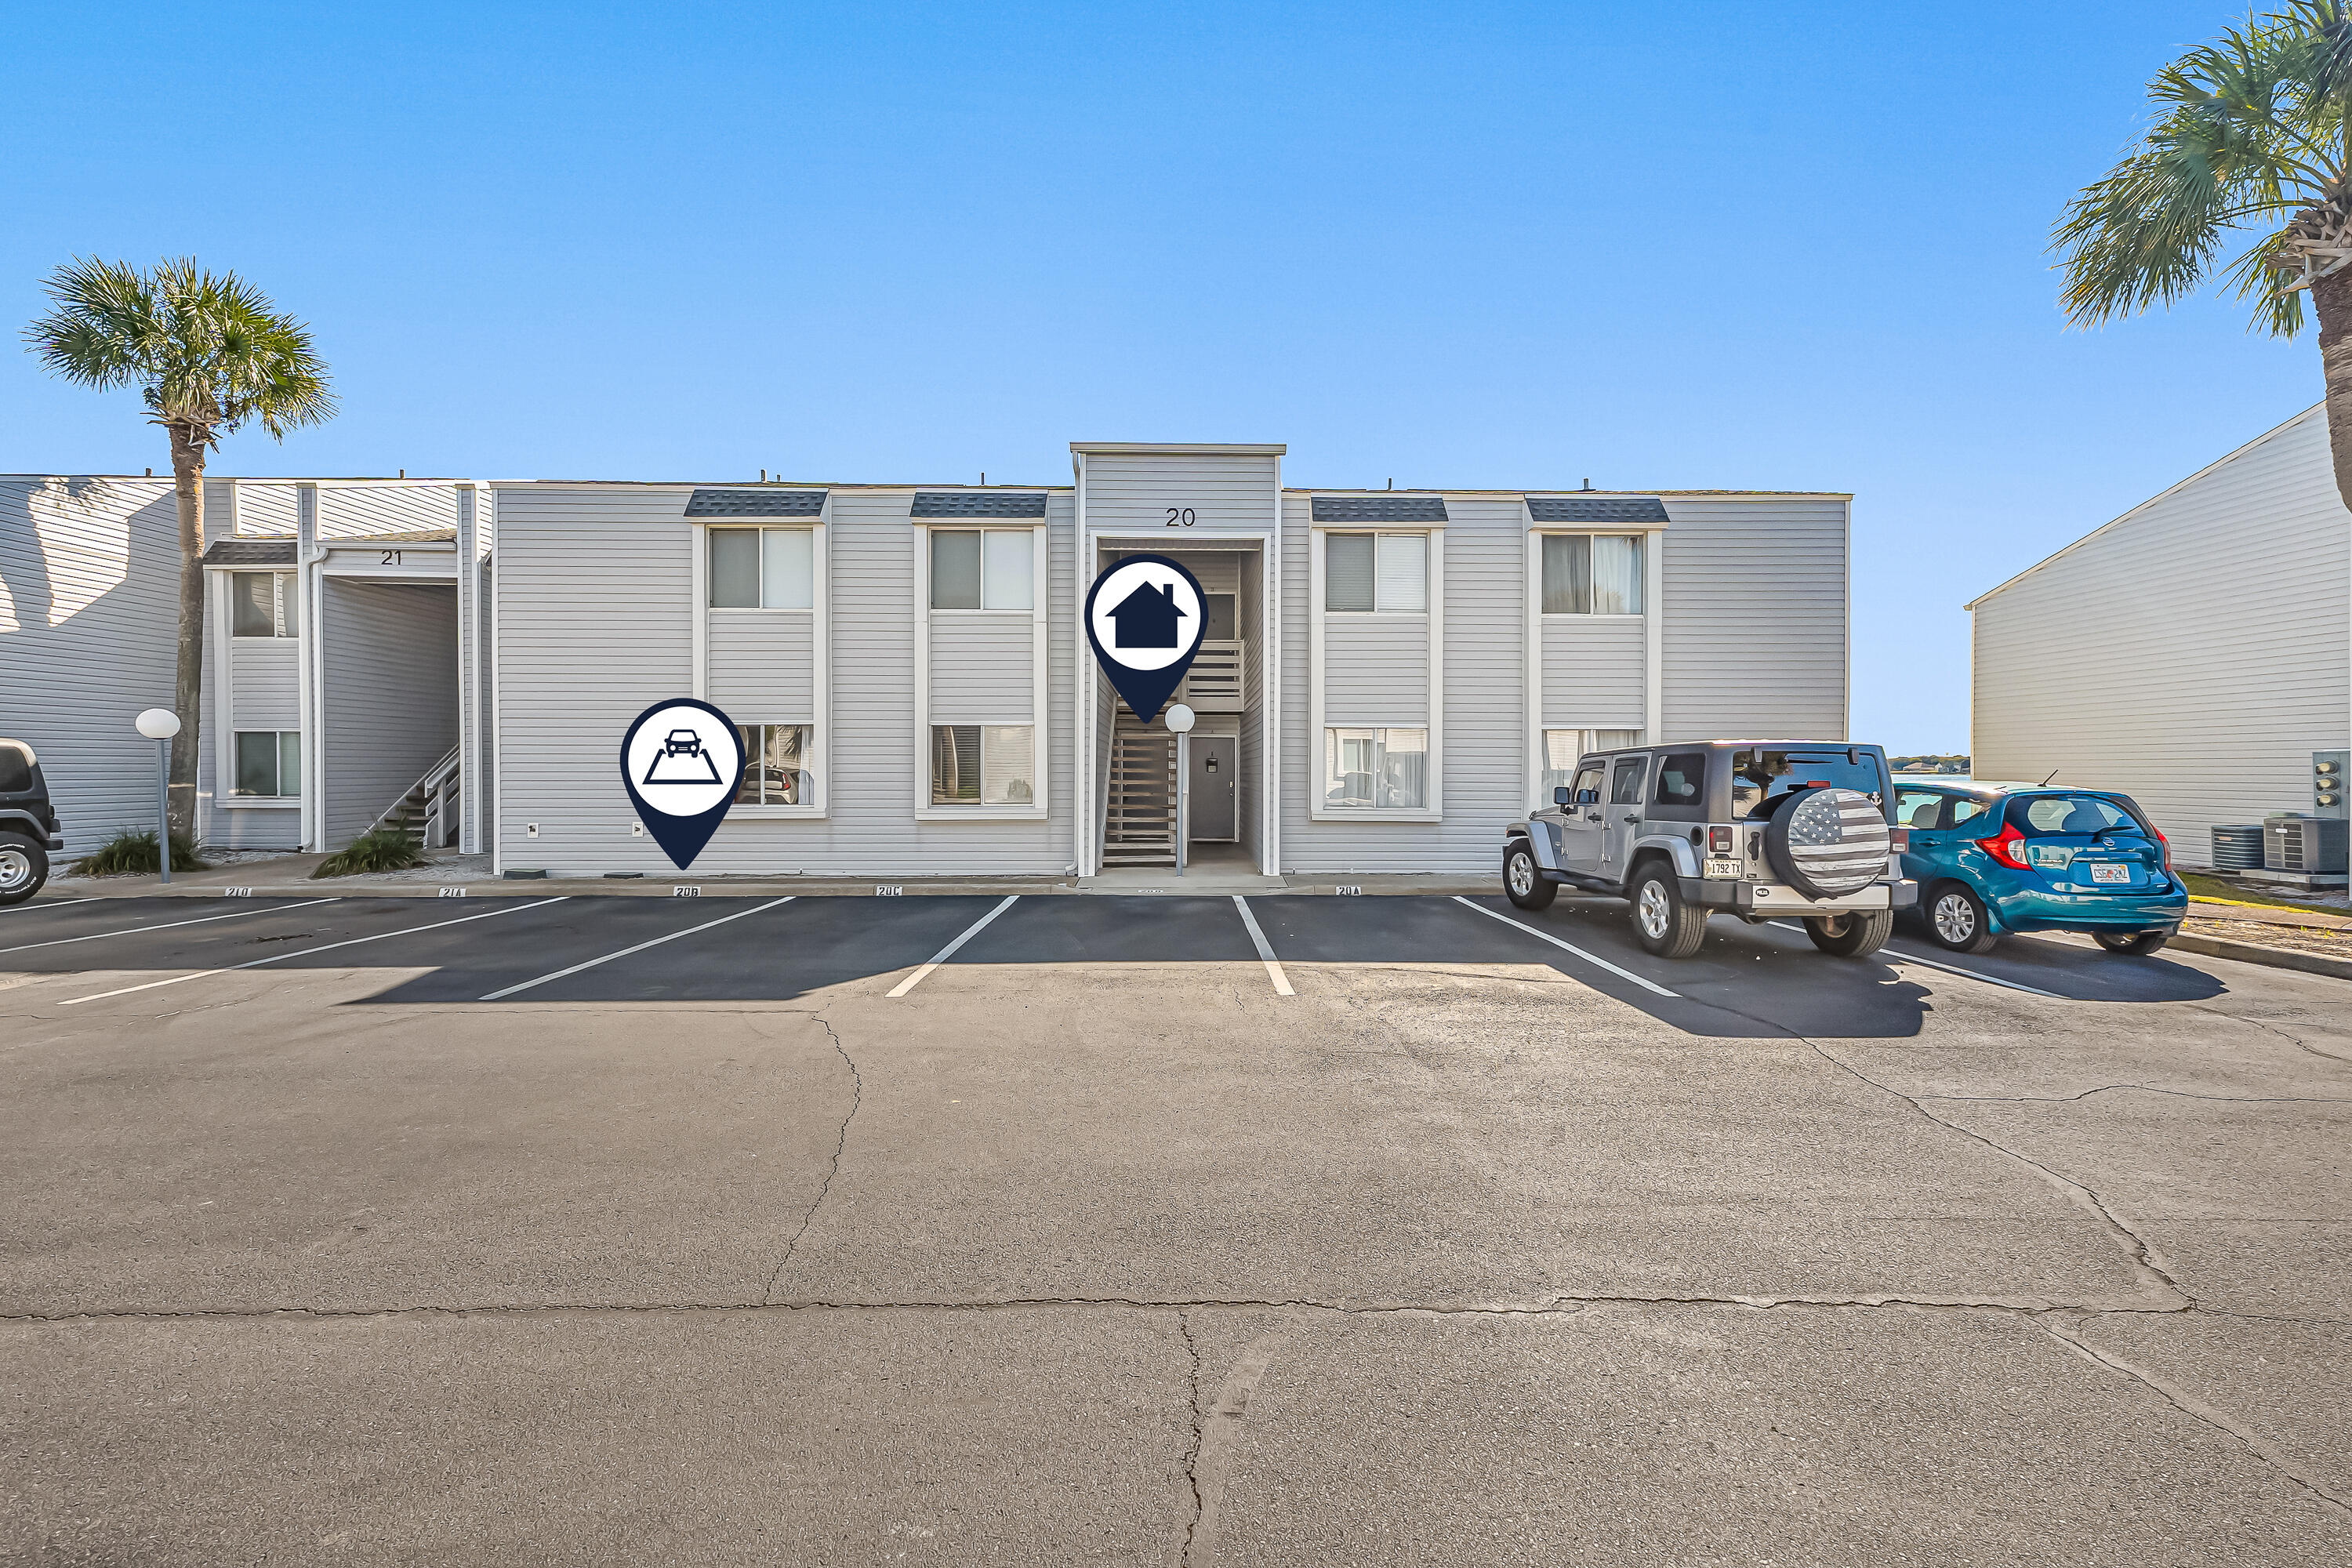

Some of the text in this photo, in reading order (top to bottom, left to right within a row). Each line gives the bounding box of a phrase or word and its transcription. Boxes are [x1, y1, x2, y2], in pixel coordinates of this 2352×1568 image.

[1166, 507, 1196, 527] 20
[381, 550, 401, 565] 21
[1711, 863, 1740, 874] 1792 TX
[443, 888, 461, 897] 21A
[878, 886, 900, 896] 20C
[1338, 886, 1359, 895] 20A
